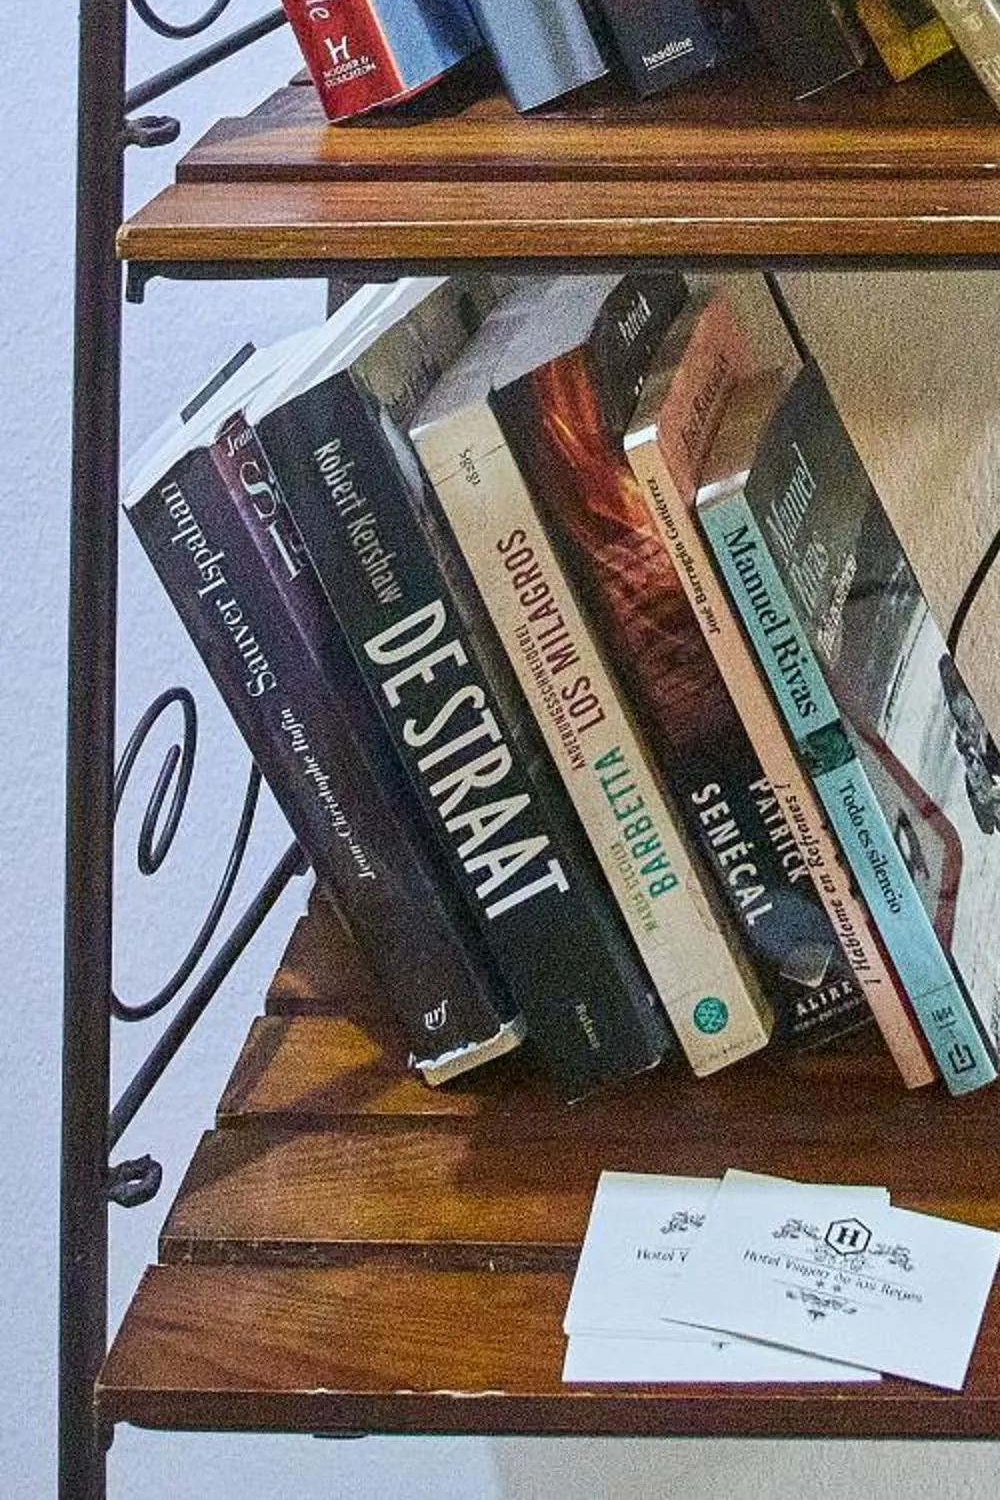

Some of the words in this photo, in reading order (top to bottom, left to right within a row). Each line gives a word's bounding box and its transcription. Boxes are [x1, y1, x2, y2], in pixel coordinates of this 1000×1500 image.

[642, 37, 694, 67] headline
[313, 437, 360, 524] Robert
[161, 480, 227, 599] Ispahan
[346, 512, 401, 605] Kershaw
[215, 598, 277, 698] Sauver
[496, 528, 580, 677] MILAGROS
[363, 598, 469, 709] DE
[560, 674, 607, 734] LOS
[722, 524, 790, 636] Manuel
[770, 633, 818, 719] Rivas
[839, 779, 865, 827] Todo
[857, 825, 871, 848] es
[866, 846, 902, 914] silencio
[403, 685, 570, 920] STRAAT
[593, 744, 680, 900] BARBETTA
[750, 776, 809, 884] PATRICK
[785, 795, 825, 870] Refranes
[691, 782, 774, 927] SENÉCAL
[818, 874, 836, 896] en
[797, 979, 853, 1017] ALIRE
[636, 1248, 674, 1261] Hotel
[743, 1249, 780, 1267] Hotel
[836, 1226, 861, 1247] H
